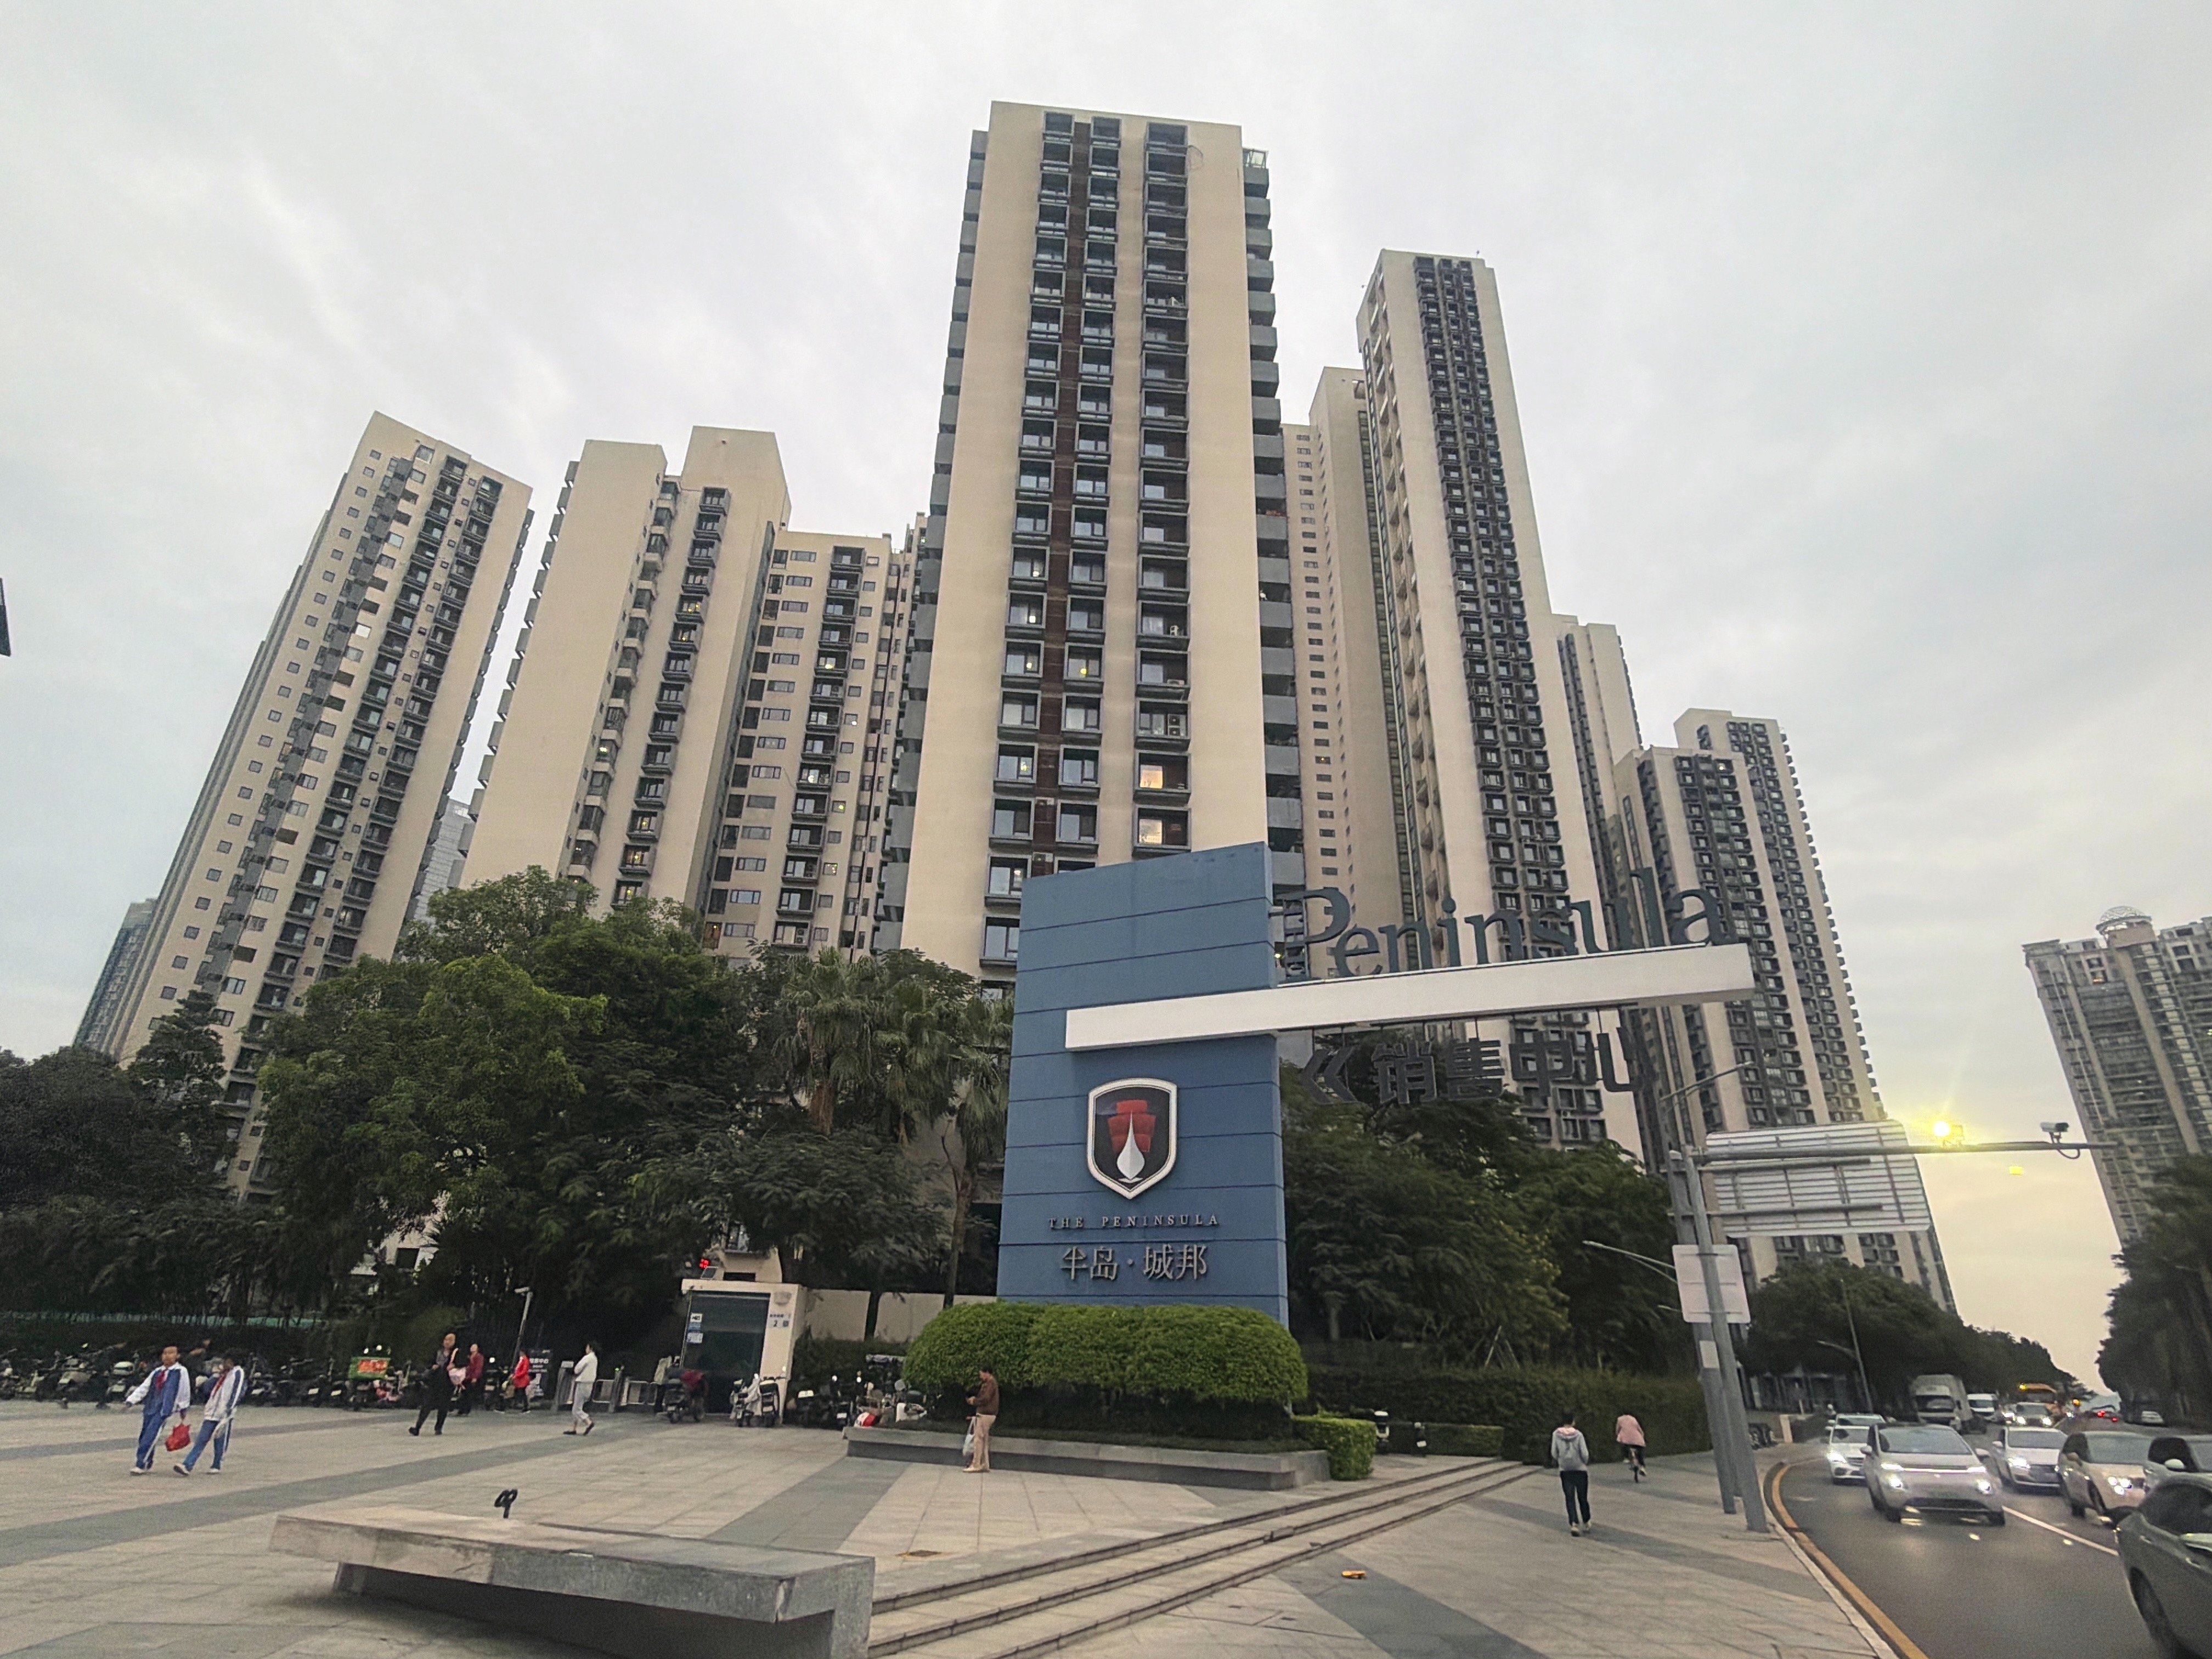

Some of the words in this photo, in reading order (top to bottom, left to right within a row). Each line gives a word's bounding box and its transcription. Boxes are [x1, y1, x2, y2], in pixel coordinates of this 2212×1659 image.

[1277, 867, 1738, 982] Peninsula
[1372, 1028, 1653, 1104] 销售中心
[1049, 1217, 1085, 1228] THE
[1102, 1214, 1218, 1227] PENINSULA
